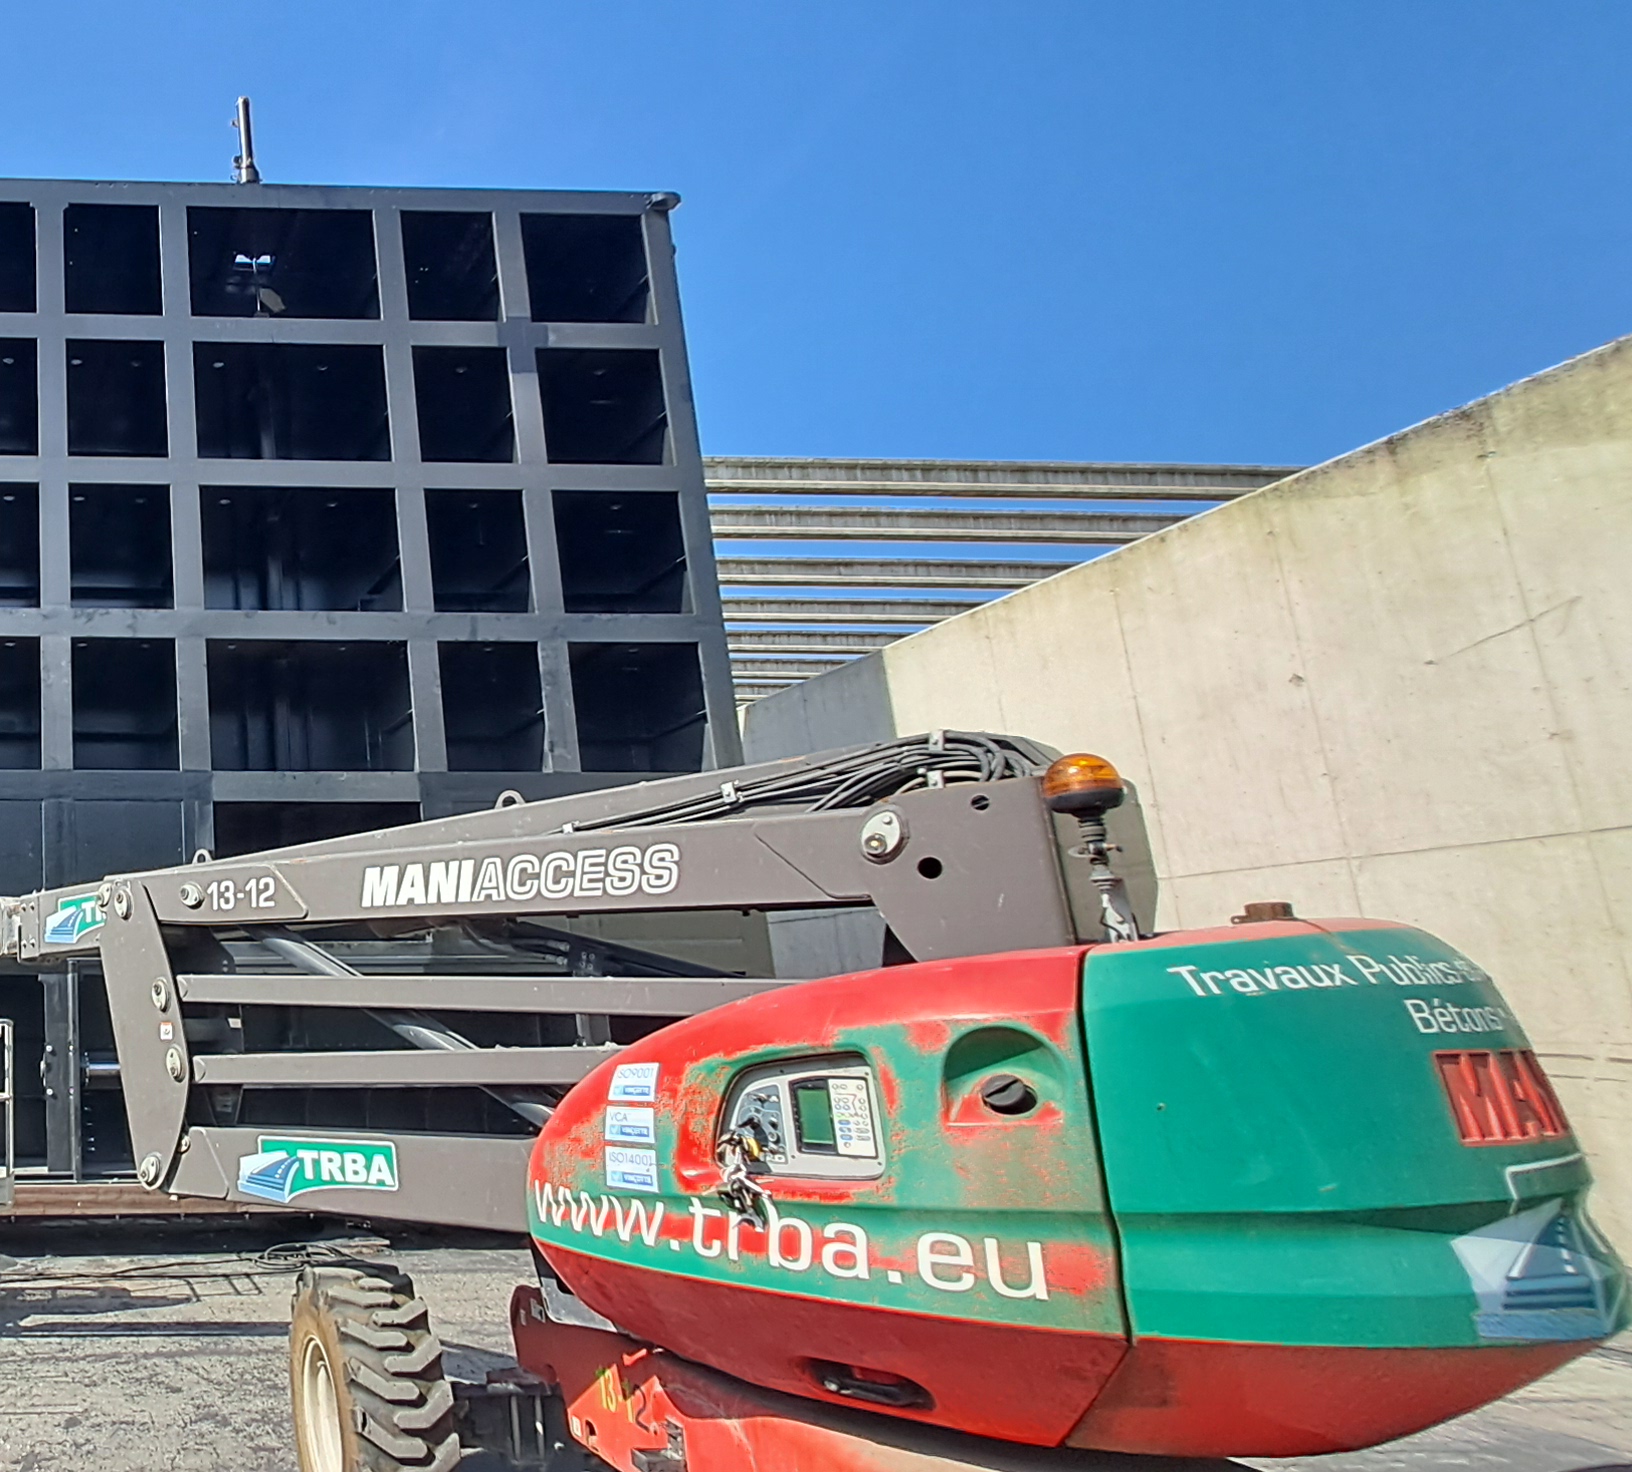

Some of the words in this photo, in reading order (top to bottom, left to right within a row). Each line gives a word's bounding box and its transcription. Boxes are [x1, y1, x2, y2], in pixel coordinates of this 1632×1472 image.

[206, 876, 276, 911] 13-12
[361, 844, 680, 907] MANIACCESS
[1167, 964, 1358, 996] Travaux
[1346, 954, 1461, 986] Publics
[1404, 997, 1505, 1034] Bétons
[609, 1112, 628, 1122] VCA
[297, 1149, 394, 1186] TRBA
[609, 1151, 652, 1166] ISO14001
[534, 1181, 1050, 1300] www.trba.eu
